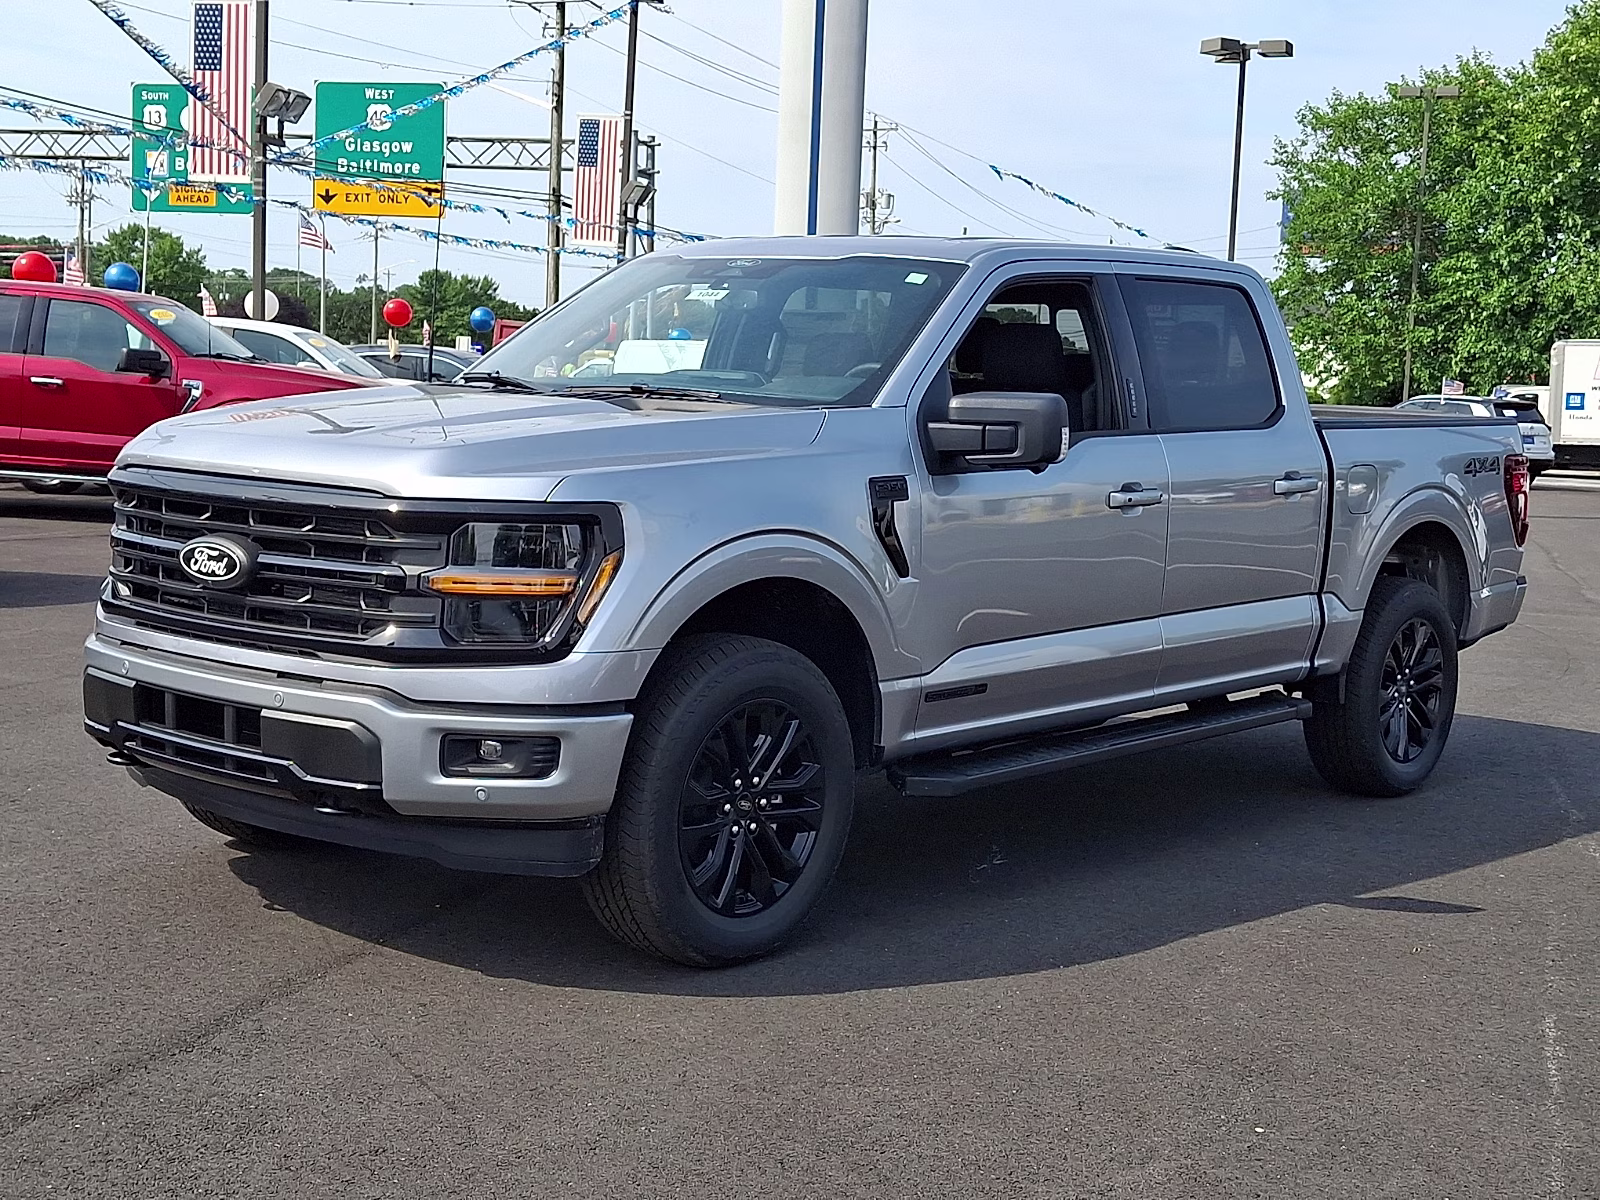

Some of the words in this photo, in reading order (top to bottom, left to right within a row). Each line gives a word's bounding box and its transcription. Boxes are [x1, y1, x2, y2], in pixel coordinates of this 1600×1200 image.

[141, 90, 169, 100] SOUTH
[364, 87, 395, 100] WEST
[148, 110, 162, 124] 13
[344, 138, 414, 158] Glasgow
[337, 158, 421, 174] Baltimore
[175, 194, 210, 204] AHEAD
[345, 192, 371, 203] EXIT
[378, 193, 410, 204] ONLY
[190, 547, 228, 575] Ford
